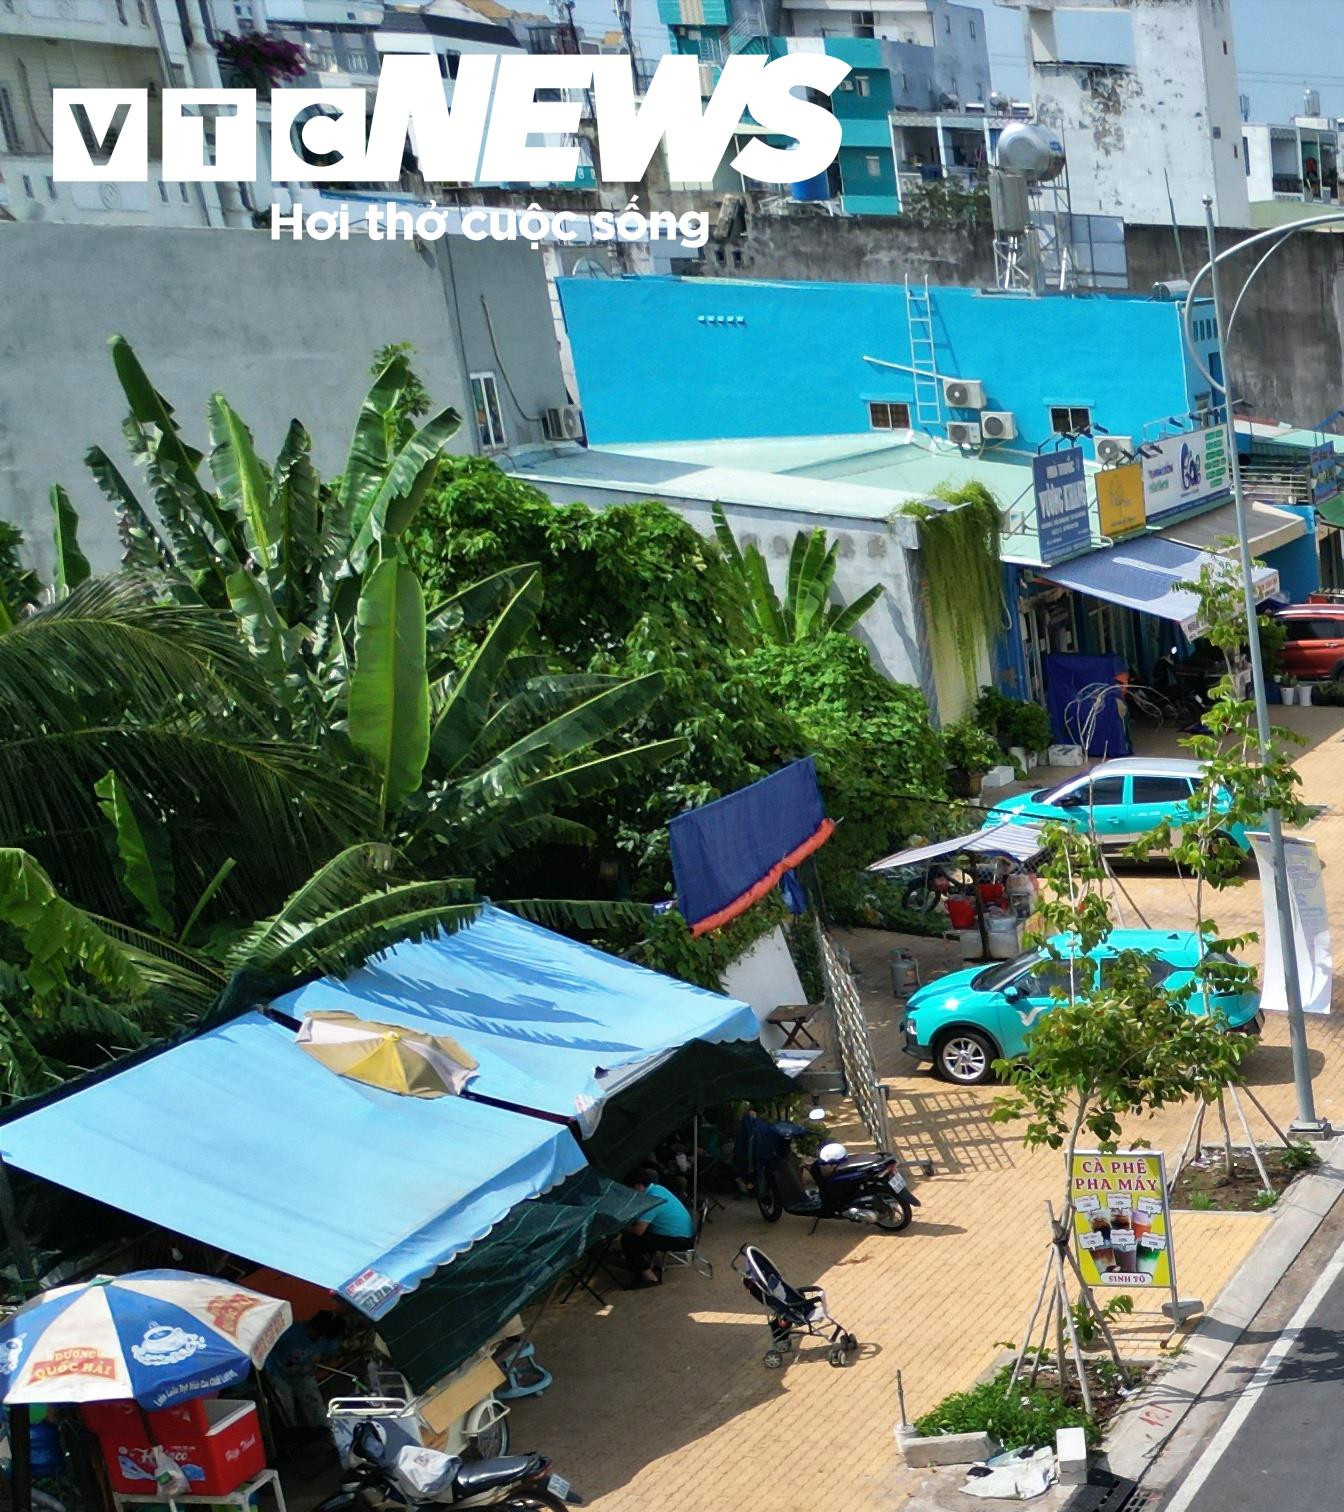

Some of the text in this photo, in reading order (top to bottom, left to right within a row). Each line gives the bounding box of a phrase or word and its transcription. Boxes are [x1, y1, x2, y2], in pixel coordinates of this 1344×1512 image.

[1082, 1157, 1147, 1174] CÀ PHÊ
[1075, 1175, 1158, 1191] PHA MÁY
